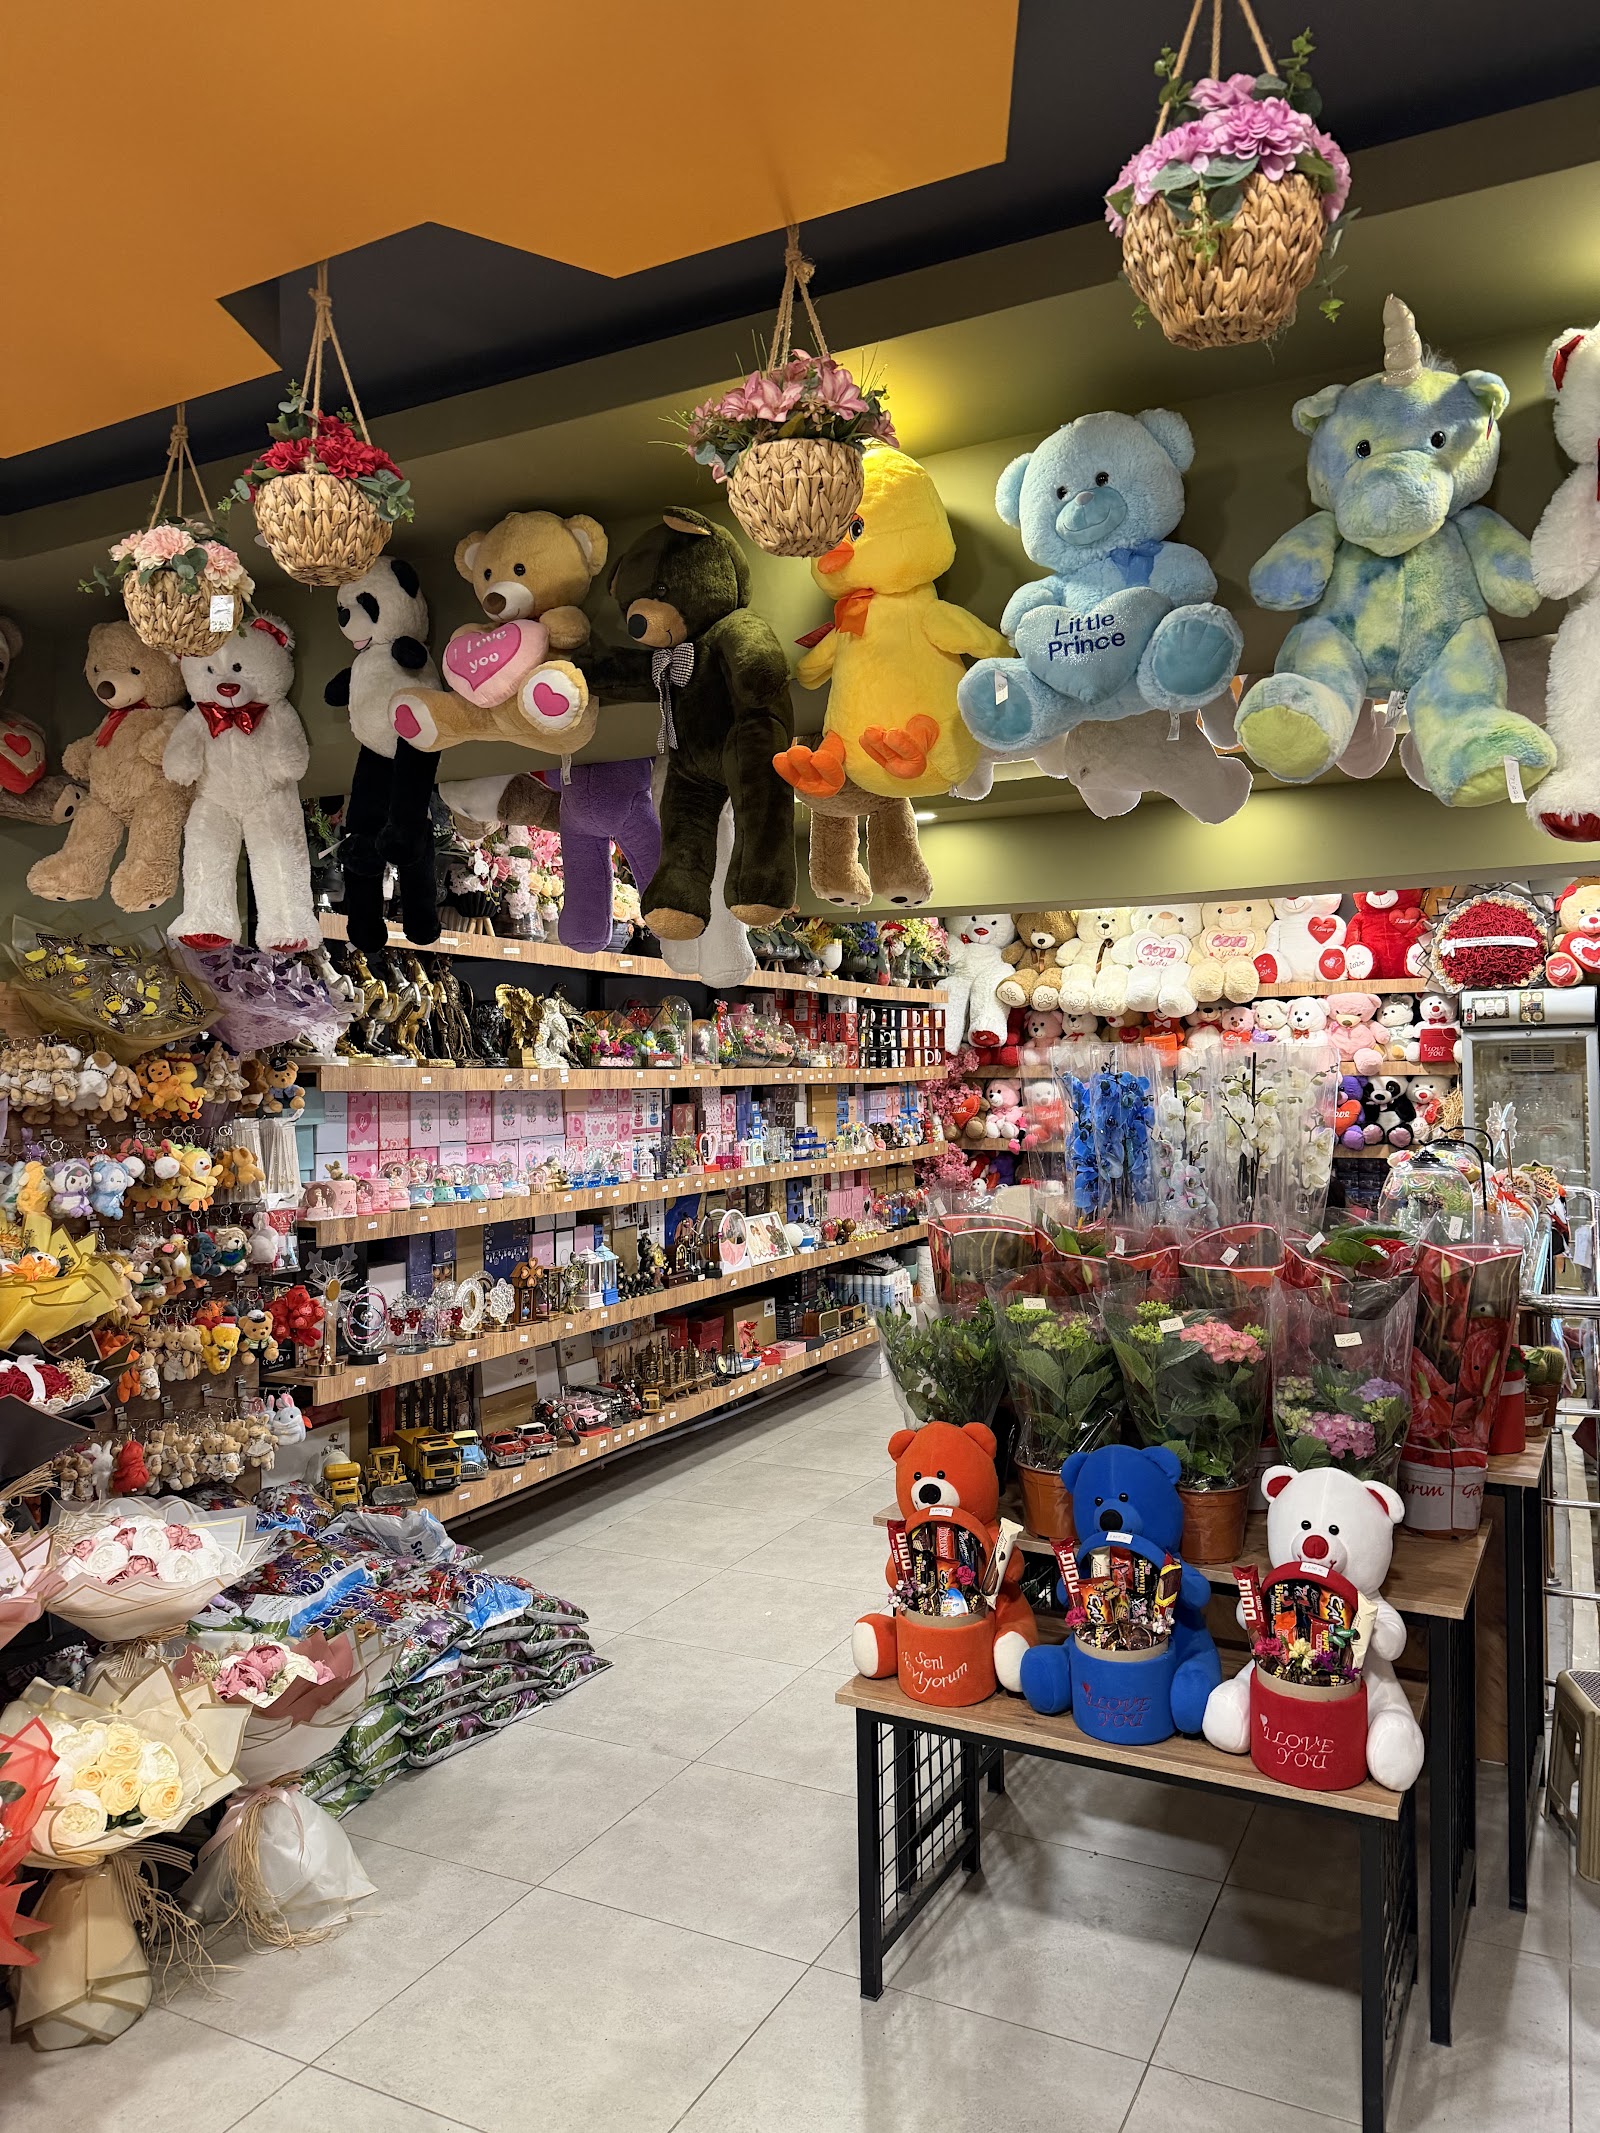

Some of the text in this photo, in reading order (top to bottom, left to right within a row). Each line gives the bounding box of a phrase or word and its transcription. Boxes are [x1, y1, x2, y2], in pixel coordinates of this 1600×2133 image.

[1055, 613, 1115, 637] Little
[467, 630, 507, 653] Love
[1048, 632, 1126, 662] Prince
[469, 652, 500, 674] you
[1339, 1337, 1357, 1346] 800
[344, 1604, 374, 1629] Flower
[1094, 1696, 1152, 1713] LOVE
[1098, 1711, 1144, 1728] YOU
[1272, 1731, 1334, 1754] LOVE
[1276, 1747, 1327, 1769] YOU
